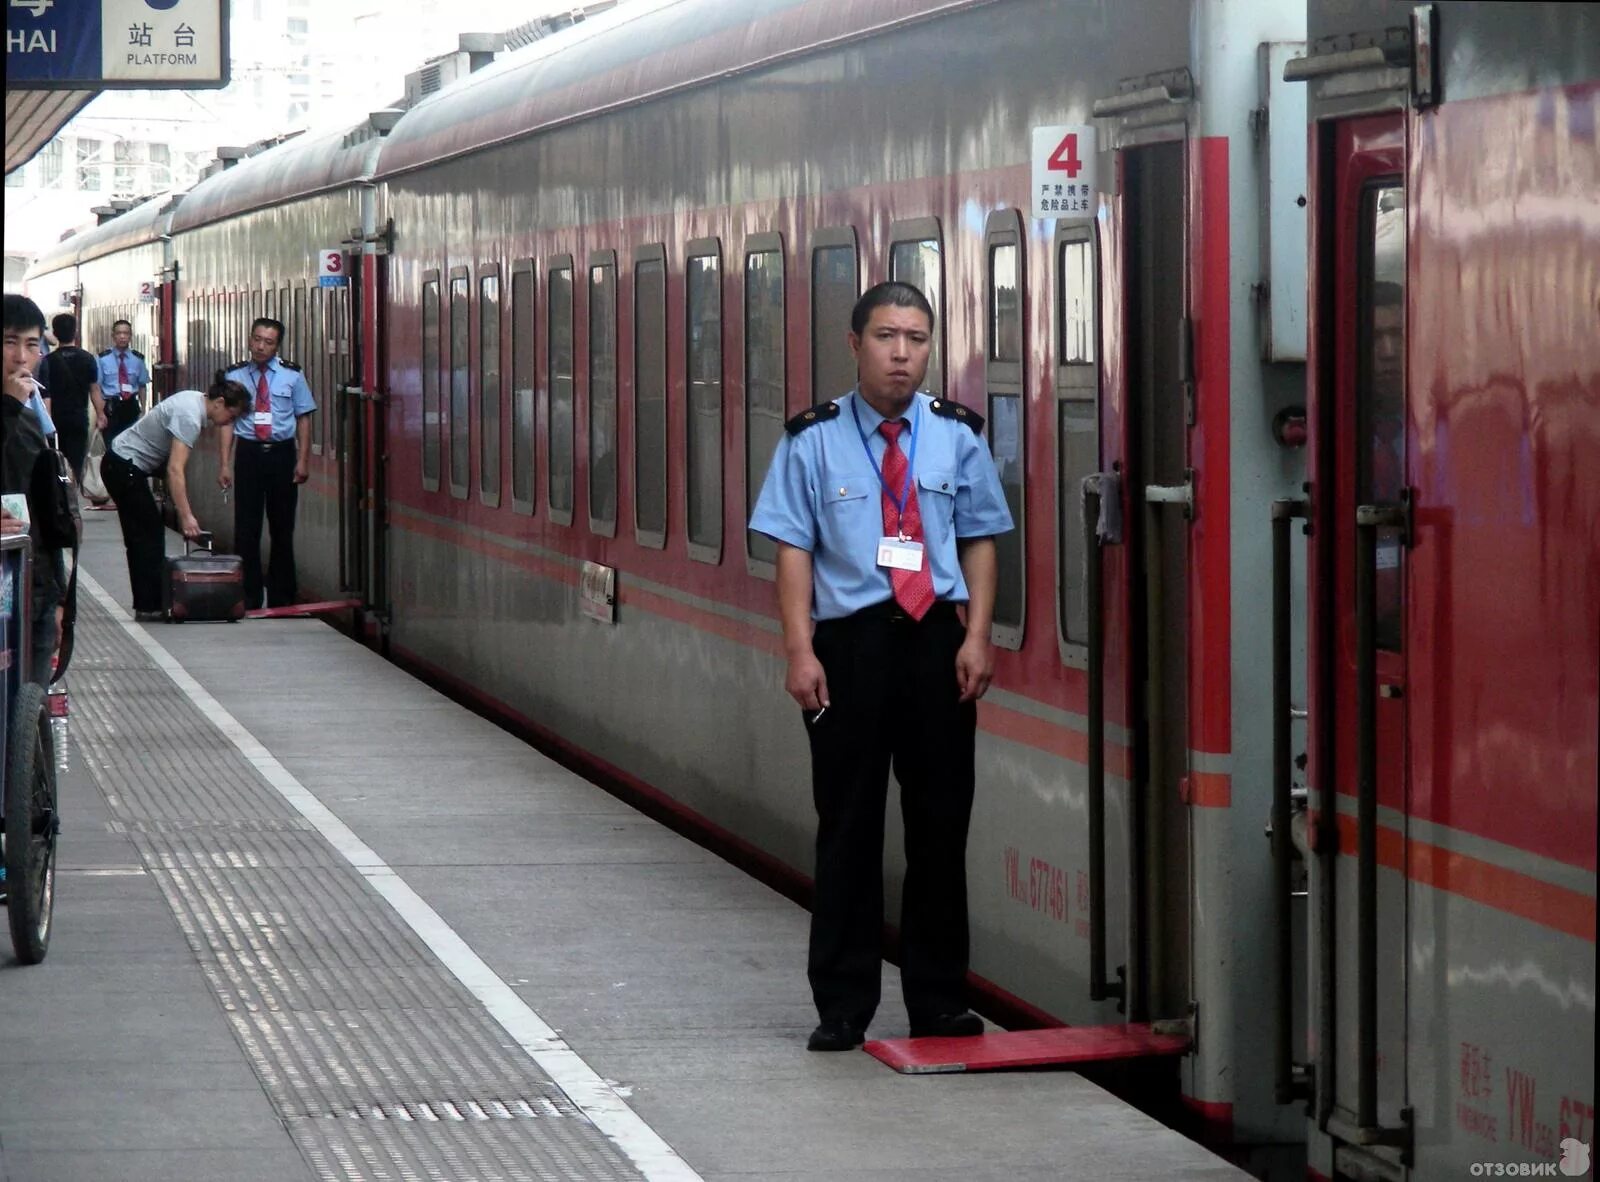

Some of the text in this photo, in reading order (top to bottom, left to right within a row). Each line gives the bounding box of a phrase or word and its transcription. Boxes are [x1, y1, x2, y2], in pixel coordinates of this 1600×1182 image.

[7, 29, 57, 53] HAI
[128, 22, 196, 48] 站台
[127, 53, 197, 65] PLATFORM
[1047, 132, 1082, 179] 4
[1041, 184, 1089, 197] 严禁携带
[1040, 199, 1089, 212] 危险品上车
[326, 253, 342, 273] 3
[141, 282, 151, 294] 2
[1505, 1066, 1536, 1152] YW
